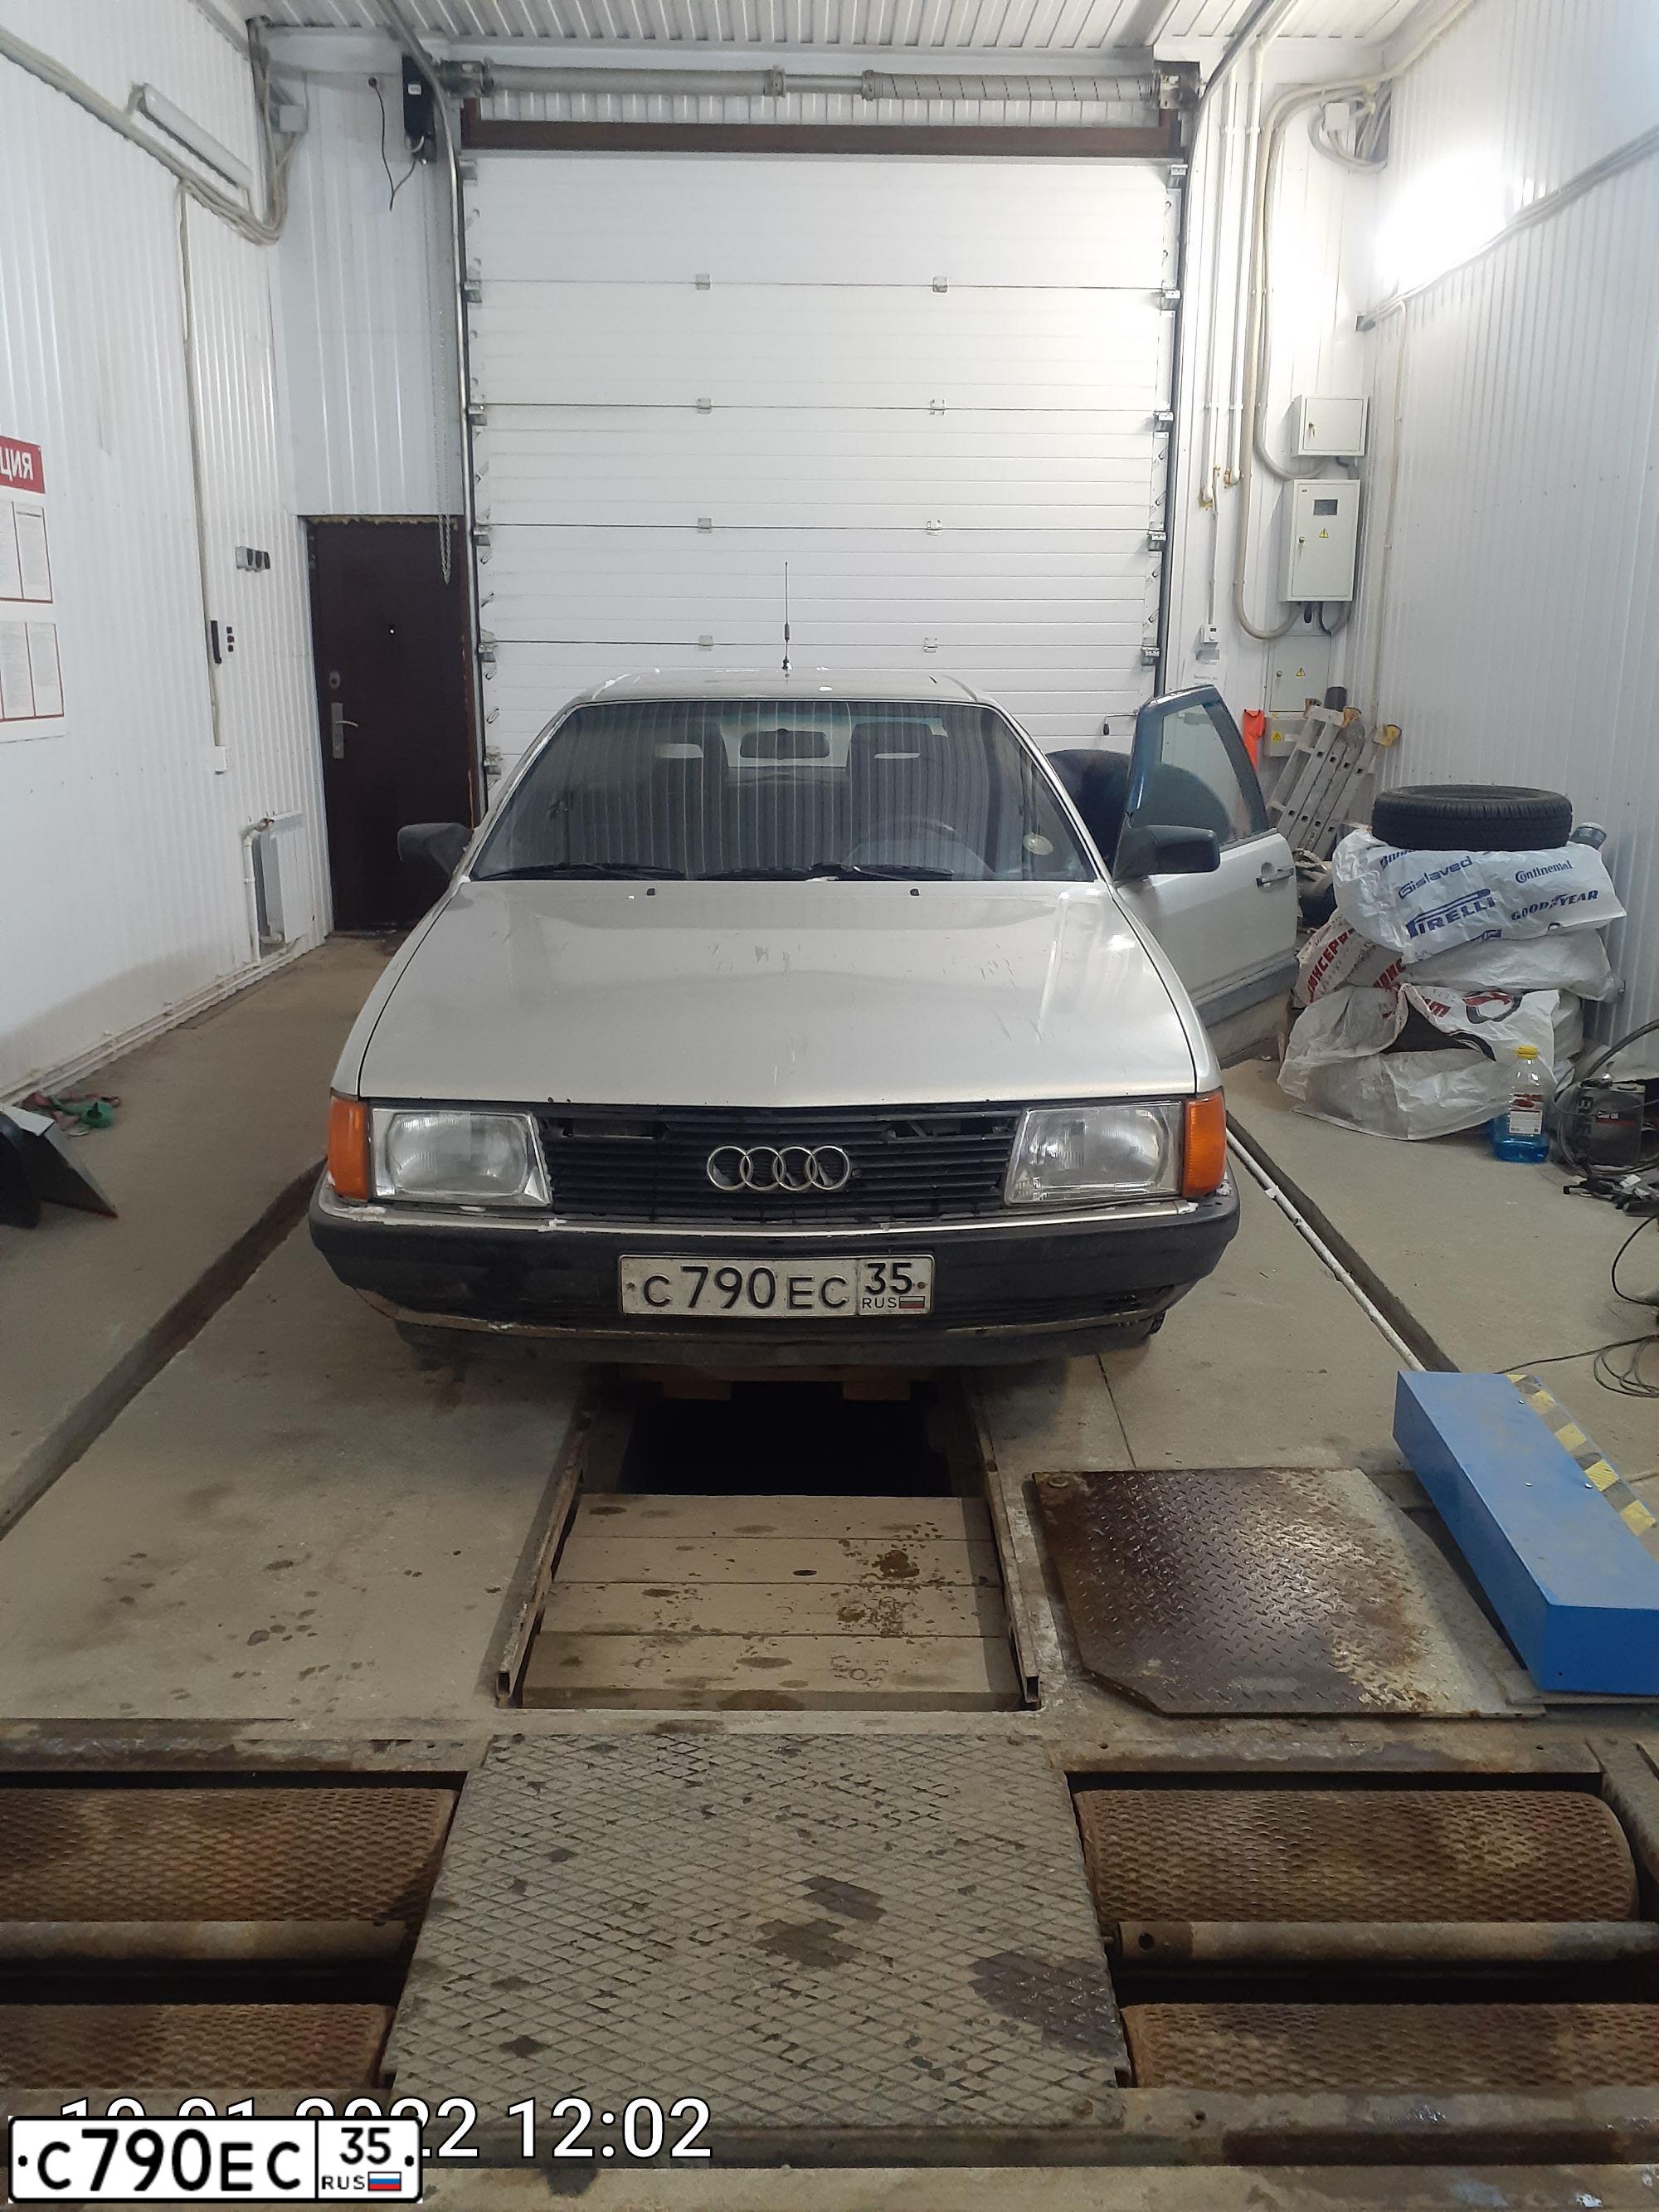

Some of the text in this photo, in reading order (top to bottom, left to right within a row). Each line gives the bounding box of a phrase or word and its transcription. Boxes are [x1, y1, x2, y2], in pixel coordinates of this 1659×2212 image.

[1399, 856, 1473, 899] Gislaved
[1515, 860, 1574, 884] Continental
[1405, 888, 1496, 939] PIRELLI
[865, 1262, 913, 1294] 35
[862, 1297, 897, 1309] RUS
